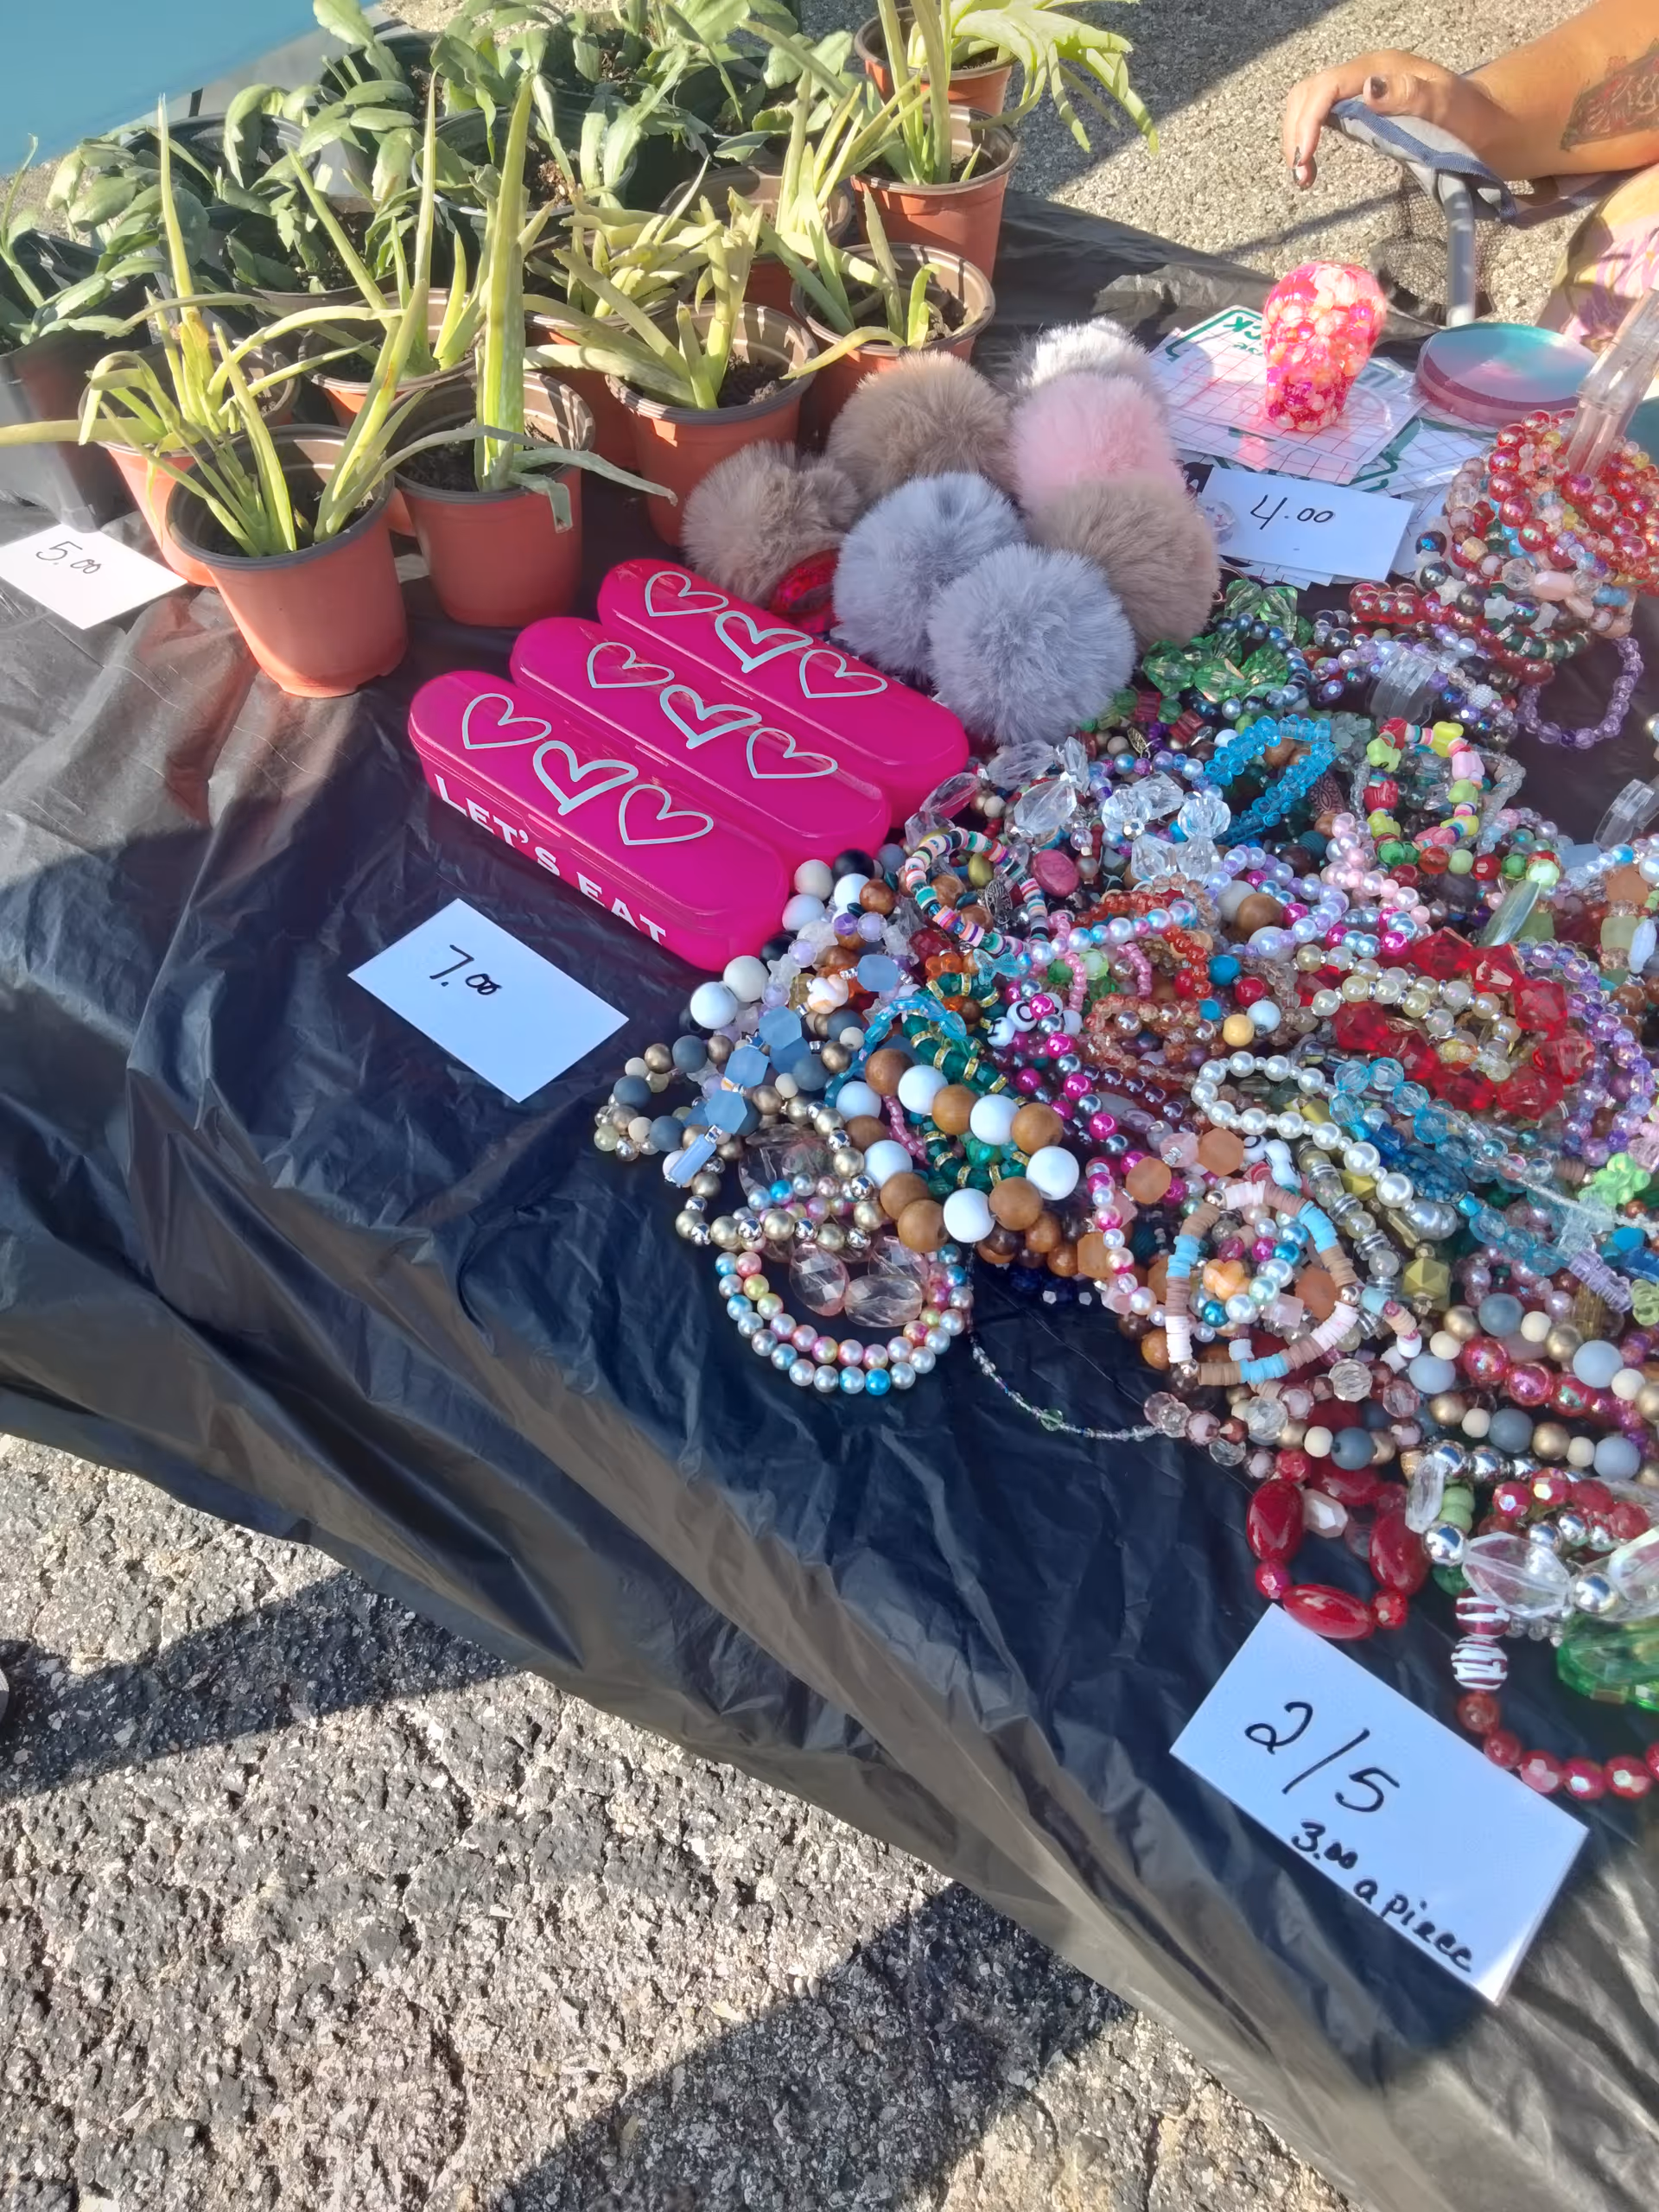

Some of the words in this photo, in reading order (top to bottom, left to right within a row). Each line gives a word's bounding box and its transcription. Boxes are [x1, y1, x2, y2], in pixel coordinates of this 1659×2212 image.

[1249, 494, 1334, 531] 4.00
[35, 540, 103, 575] 5.00
[435, 773, 560, 877] LET'S
[575, 871, 667, 945] EAT
[429, 944, 503, 996] 7.00
[1244, 1701, 1400, 1813] 2/5
[1290, 1821, 1359, 1871] 3.00
